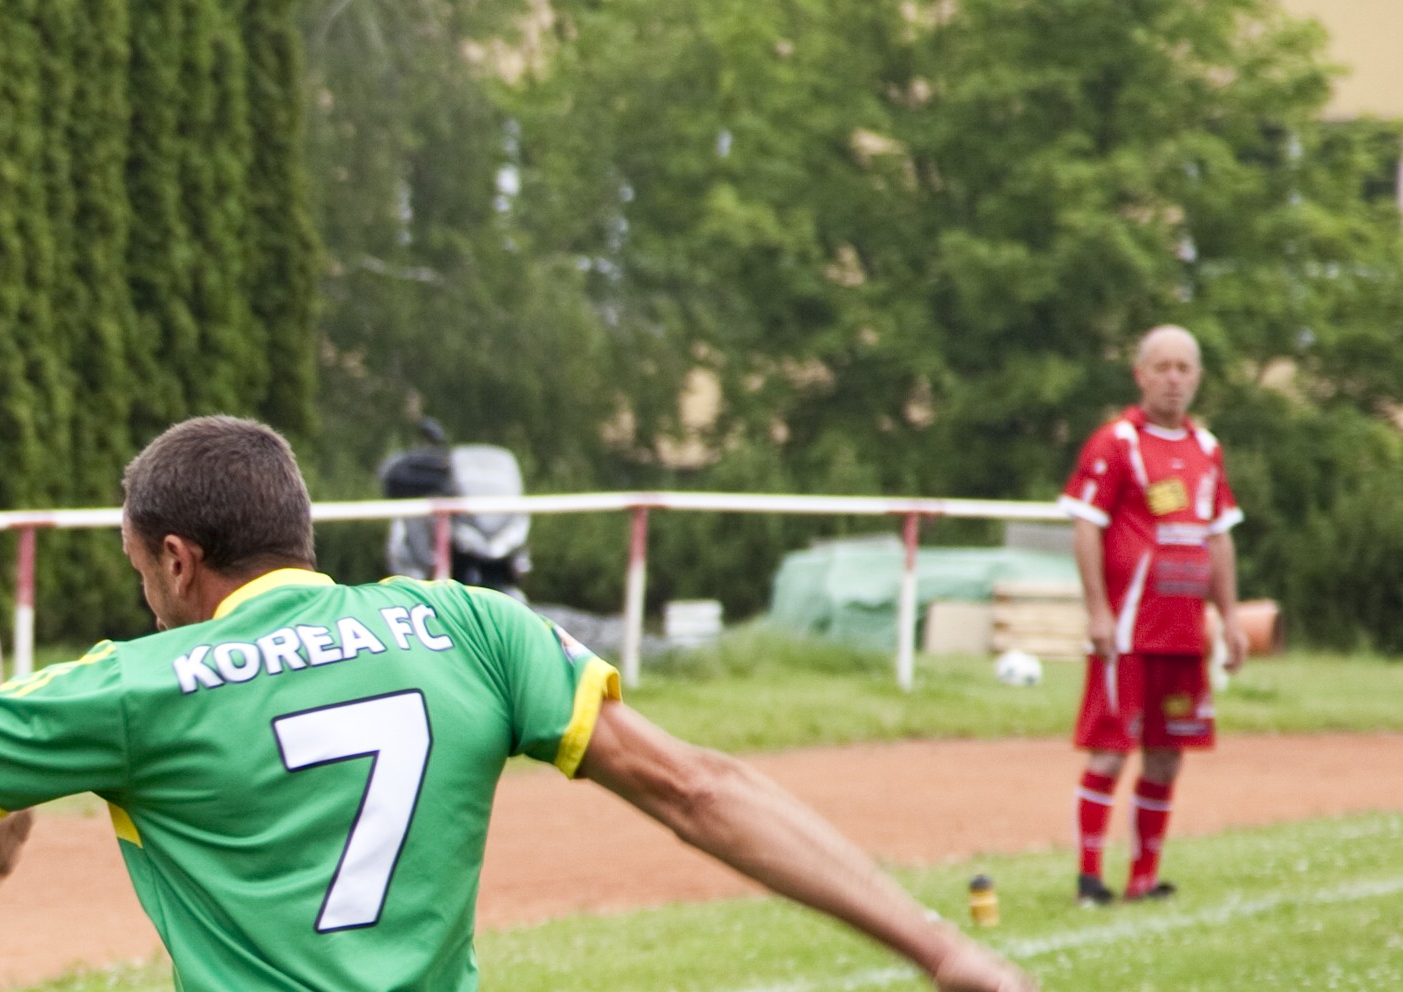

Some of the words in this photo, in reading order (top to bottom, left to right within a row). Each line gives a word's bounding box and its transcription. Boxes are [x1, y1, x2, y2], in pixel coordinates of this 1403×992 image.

[172, 616, 387, 694] KOREA
[379, 603, 454, 651] FC
[270, 688, 434, 935] 7
